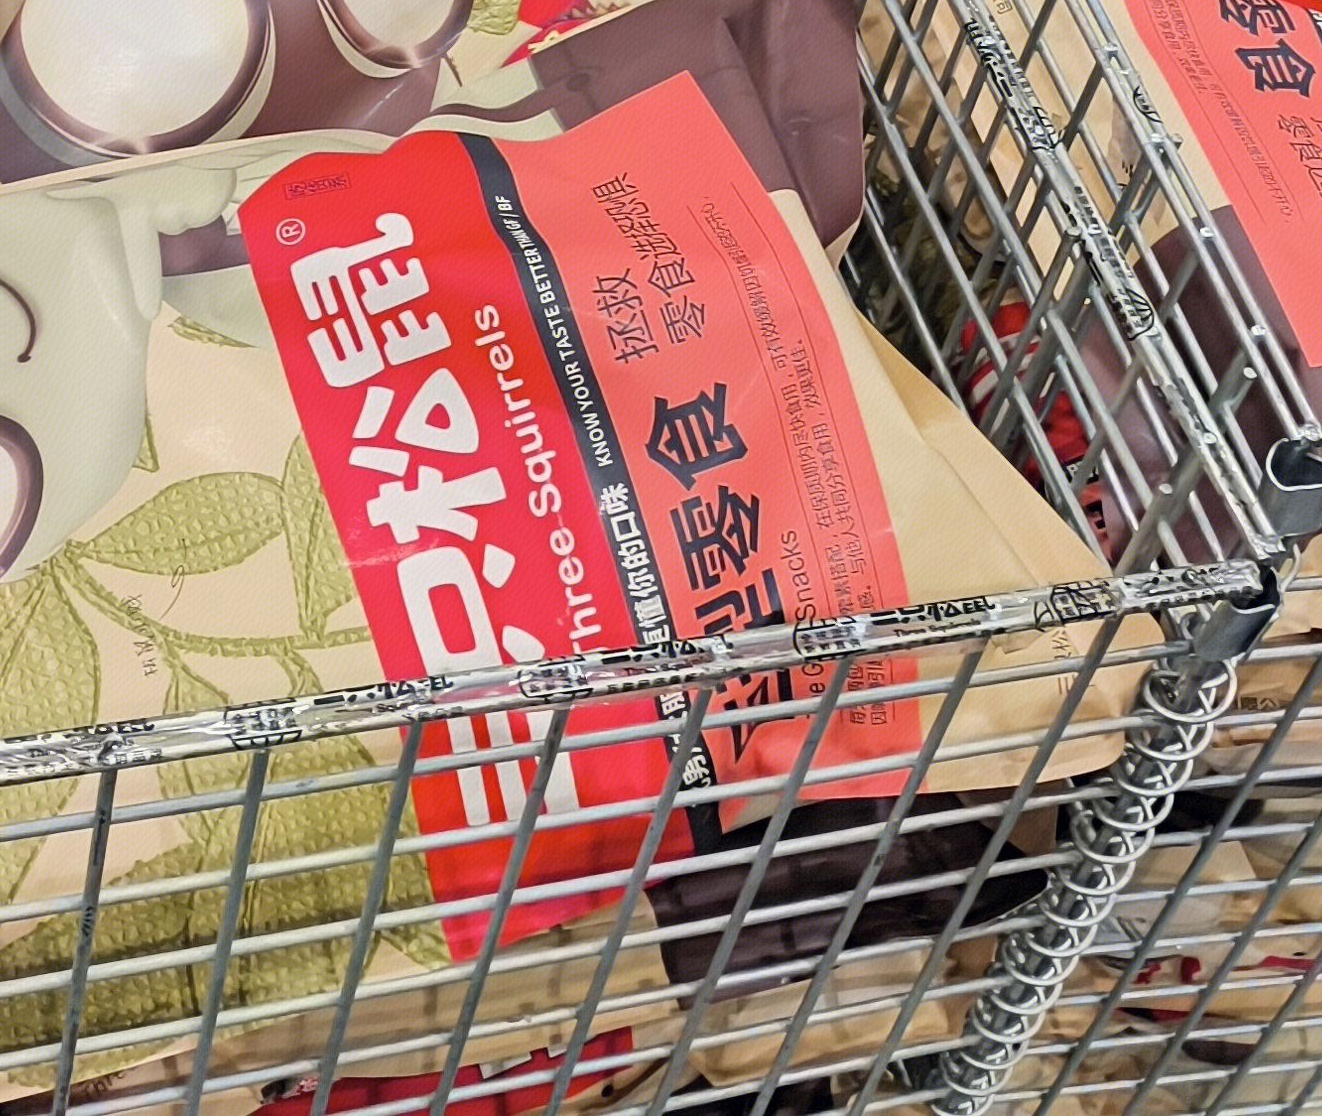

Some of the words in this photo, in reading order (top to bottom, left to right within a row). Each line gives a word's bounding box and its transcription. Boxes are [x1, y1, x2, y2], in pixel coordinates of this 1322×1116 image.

[495, 195, 514, 211] BF
[524, 244, 556, 303] BETTER
[591, 172, 708, 348] 零食选择恐惧
[543, 304, 573, 361] TASTE
[592, 267, 661, 365] 拯救
[473, 302, 564, 520] Squirrels
[564, 360, 593, 412] YOUR
[583, 412, 614, 468] KNOW
[780, 528, 817, 623] Snacks
